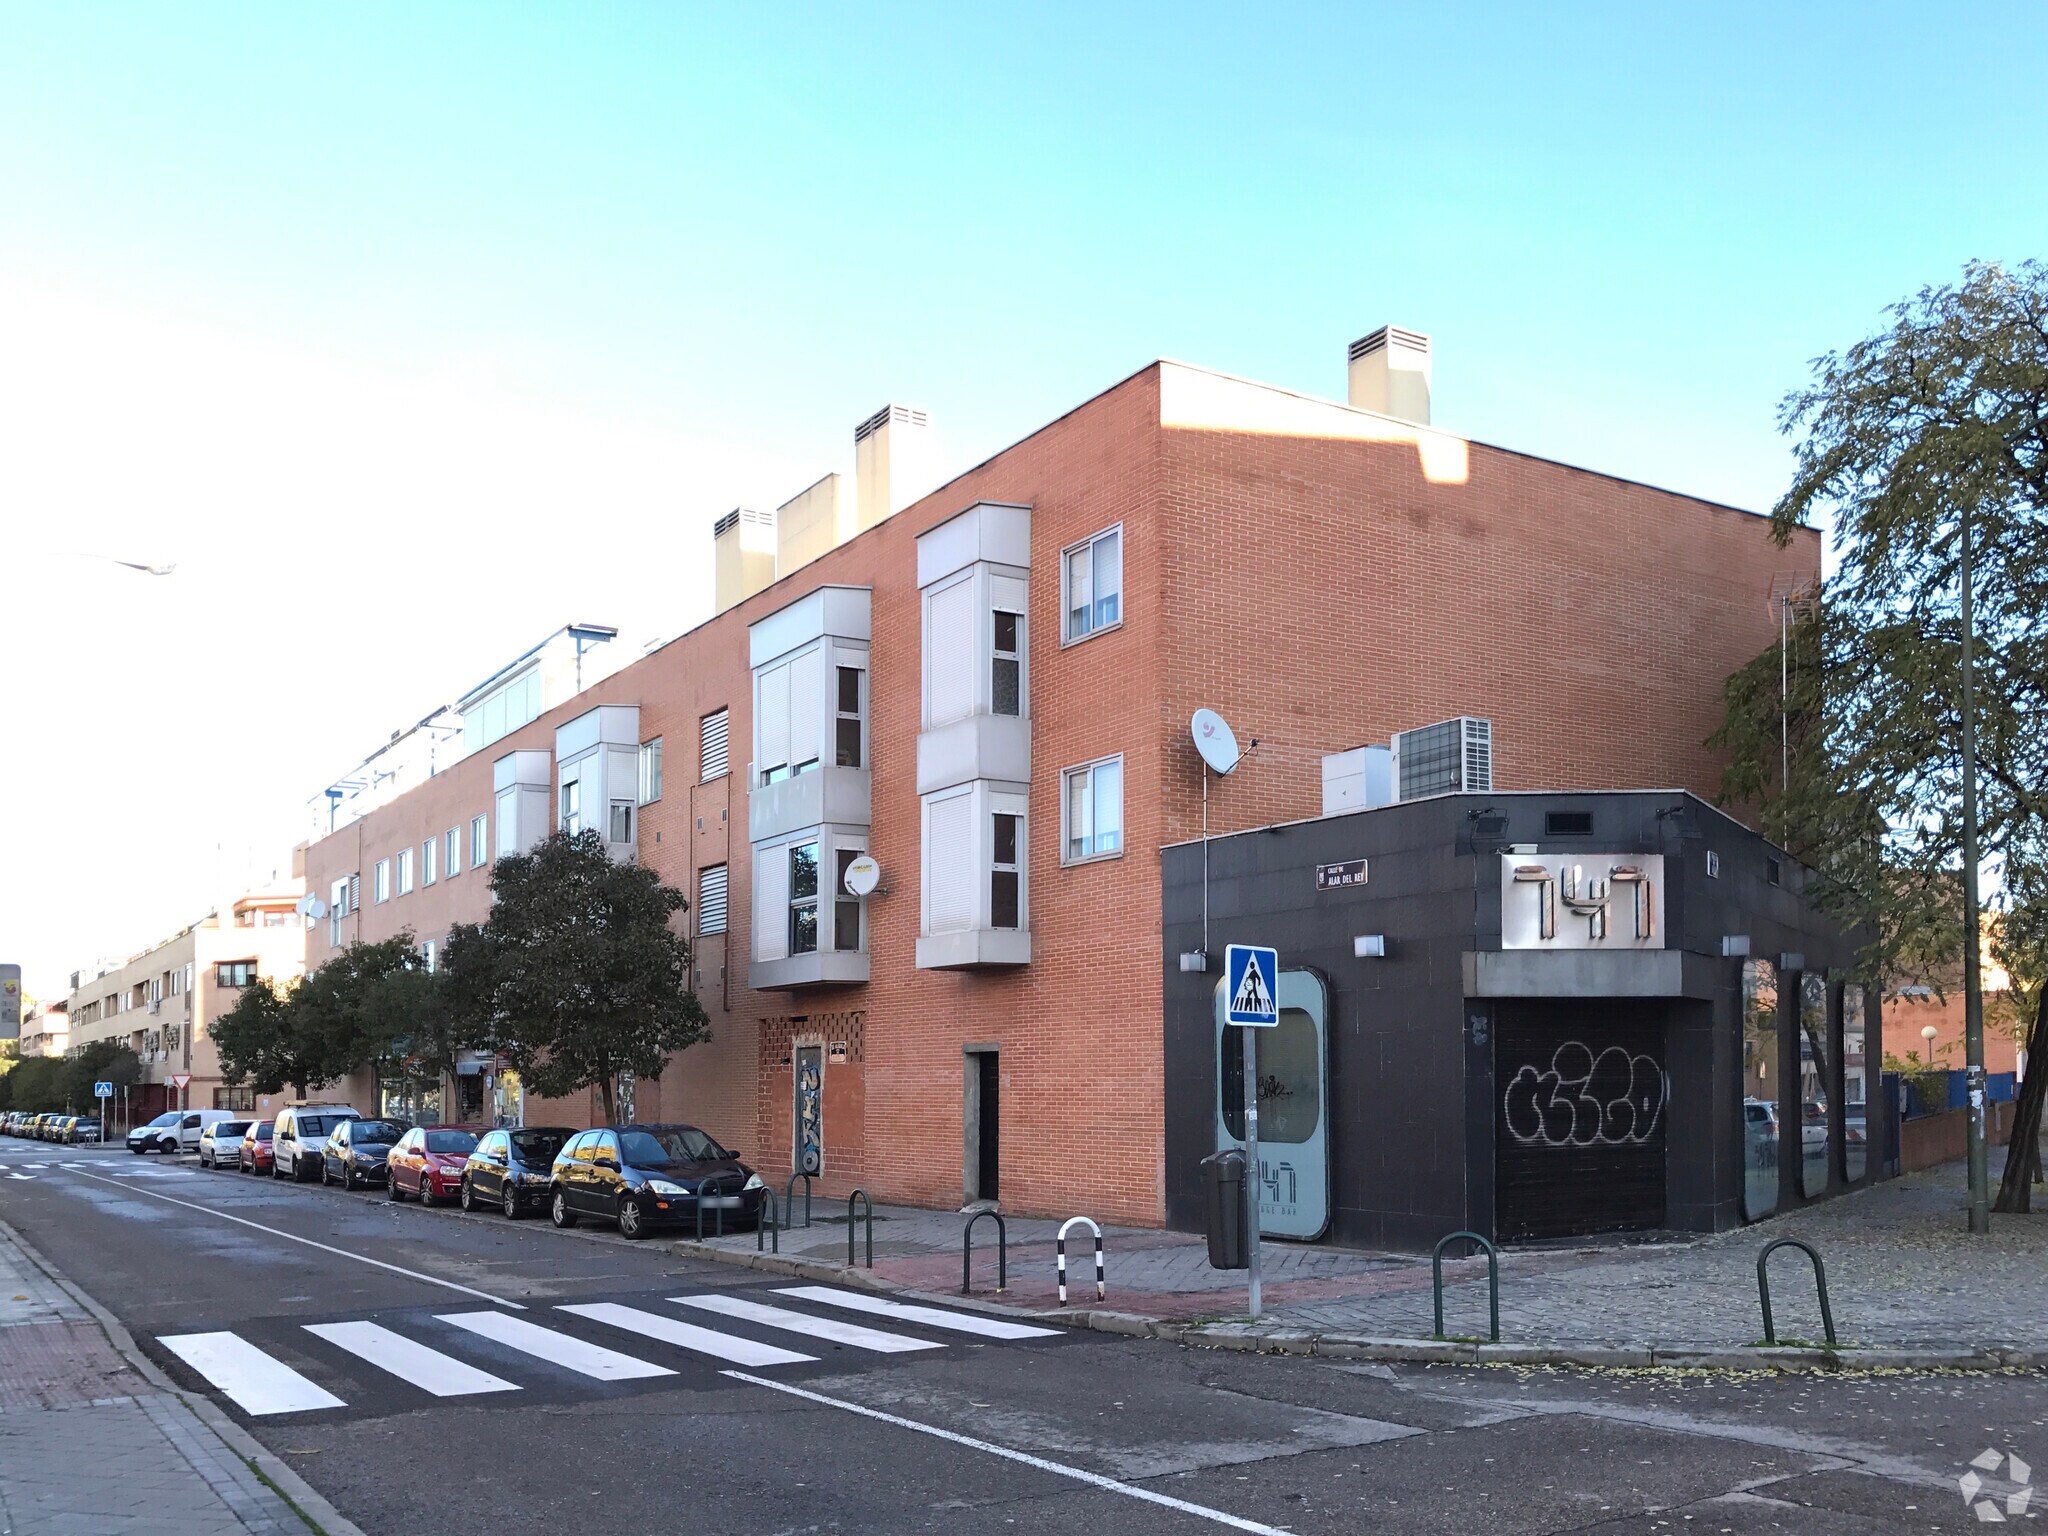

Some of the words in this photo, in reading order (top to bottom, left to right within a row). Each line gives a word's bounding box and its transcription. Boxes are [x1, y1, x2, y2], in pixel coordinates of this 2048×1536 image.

[1328, 876, 1341, 886] ALAR
[1342, 874, 1352, 884] DEL
[1354, 872, 1364, 882] REY
[1513, 864, 1657, 939] 747
[1257, 1159, 1296, 1204] 47
[1281, 1207, 1296, 1216] BAR
